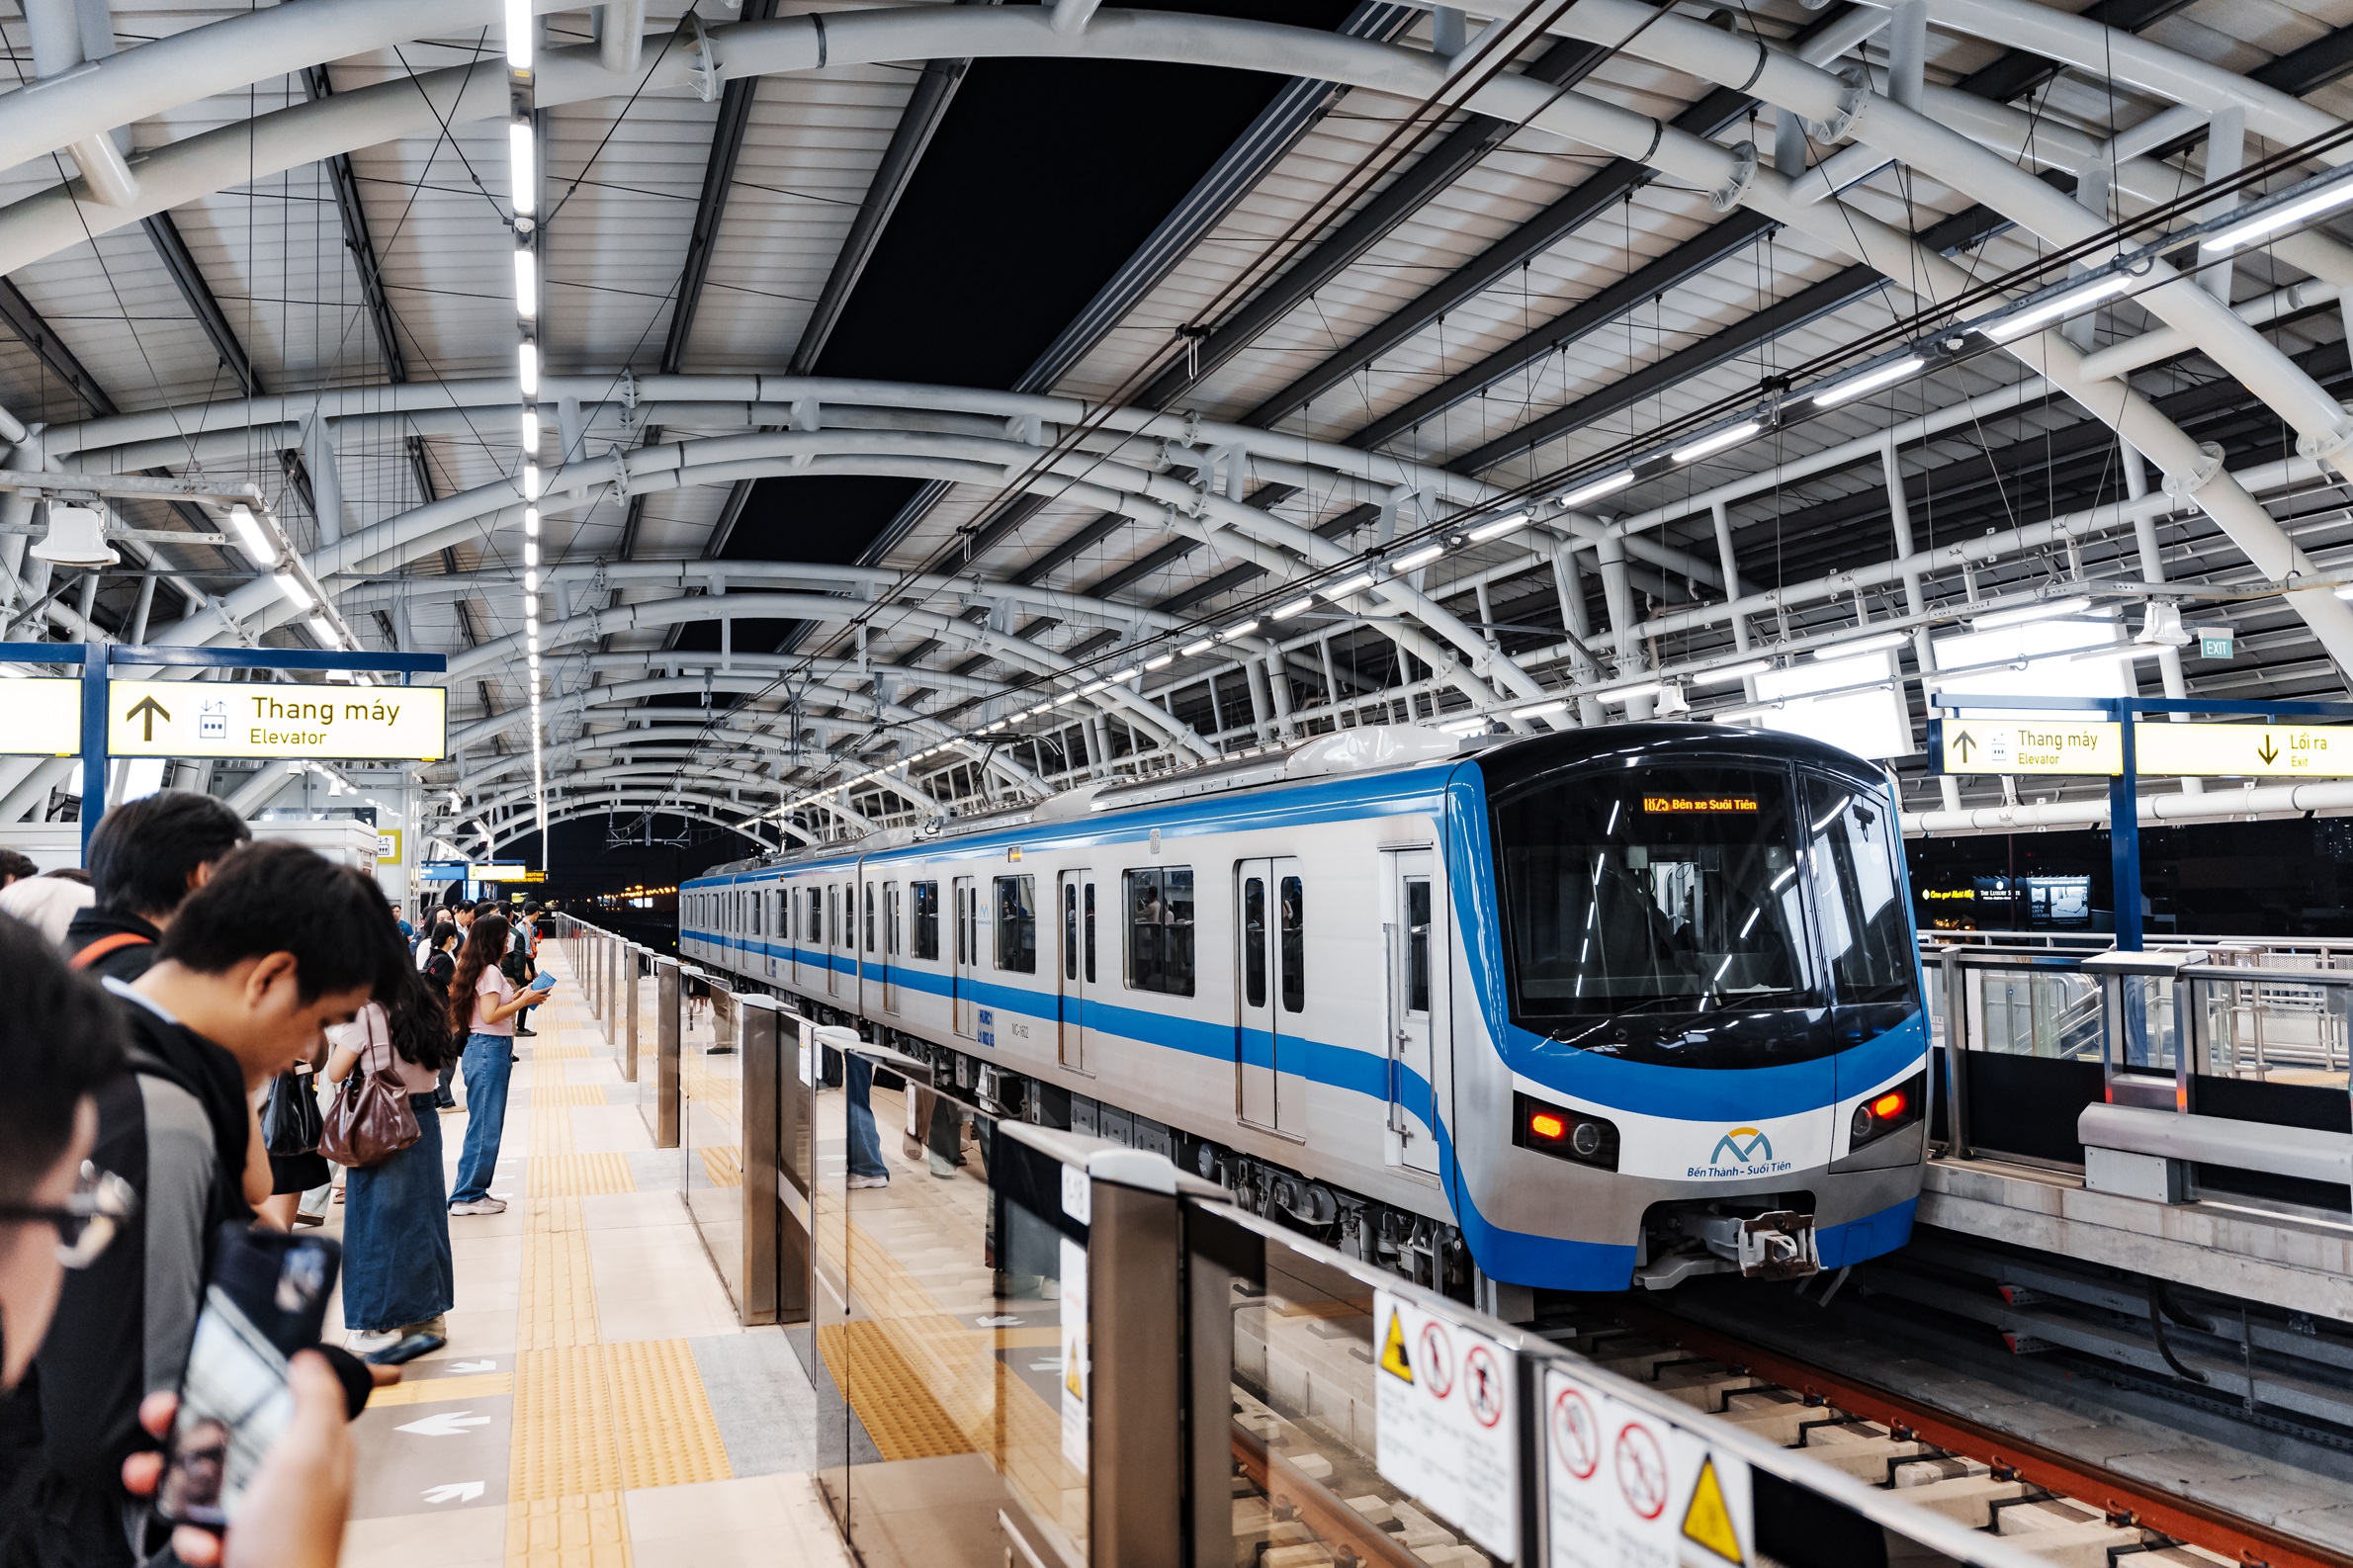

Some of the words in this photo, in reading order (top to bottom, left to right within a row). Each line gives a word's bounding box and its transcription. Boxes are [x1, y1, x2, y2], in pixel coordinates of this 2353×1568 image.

[2206, 641, 2227, 654] EXIT
[251, 696, 334, 725] Thang
[345, 698, 400, 727] máy
[250, 728, 327, 744] Elevator
[2018, 730, 2062, 750] Thang
[2067, 731, 2098, 751] máy
[2290, 732, 2310, 750] Lối
[2313, 739, 2327, 750] ra
[2018, 752, 2060, 764] Elevator
[2291, 755, 2309, 767] Exit
[1695, 801, 1707, 810] xe
[1733, 799, 1757, 810] Tiên
[1687, 1166, 1706, 1177] Bến
[1708, 1166, 1739, 1177] Thành
[1747, 1163, 1770, 1176] Suối
[1771, 1161, 1791, 1173] Tiên
